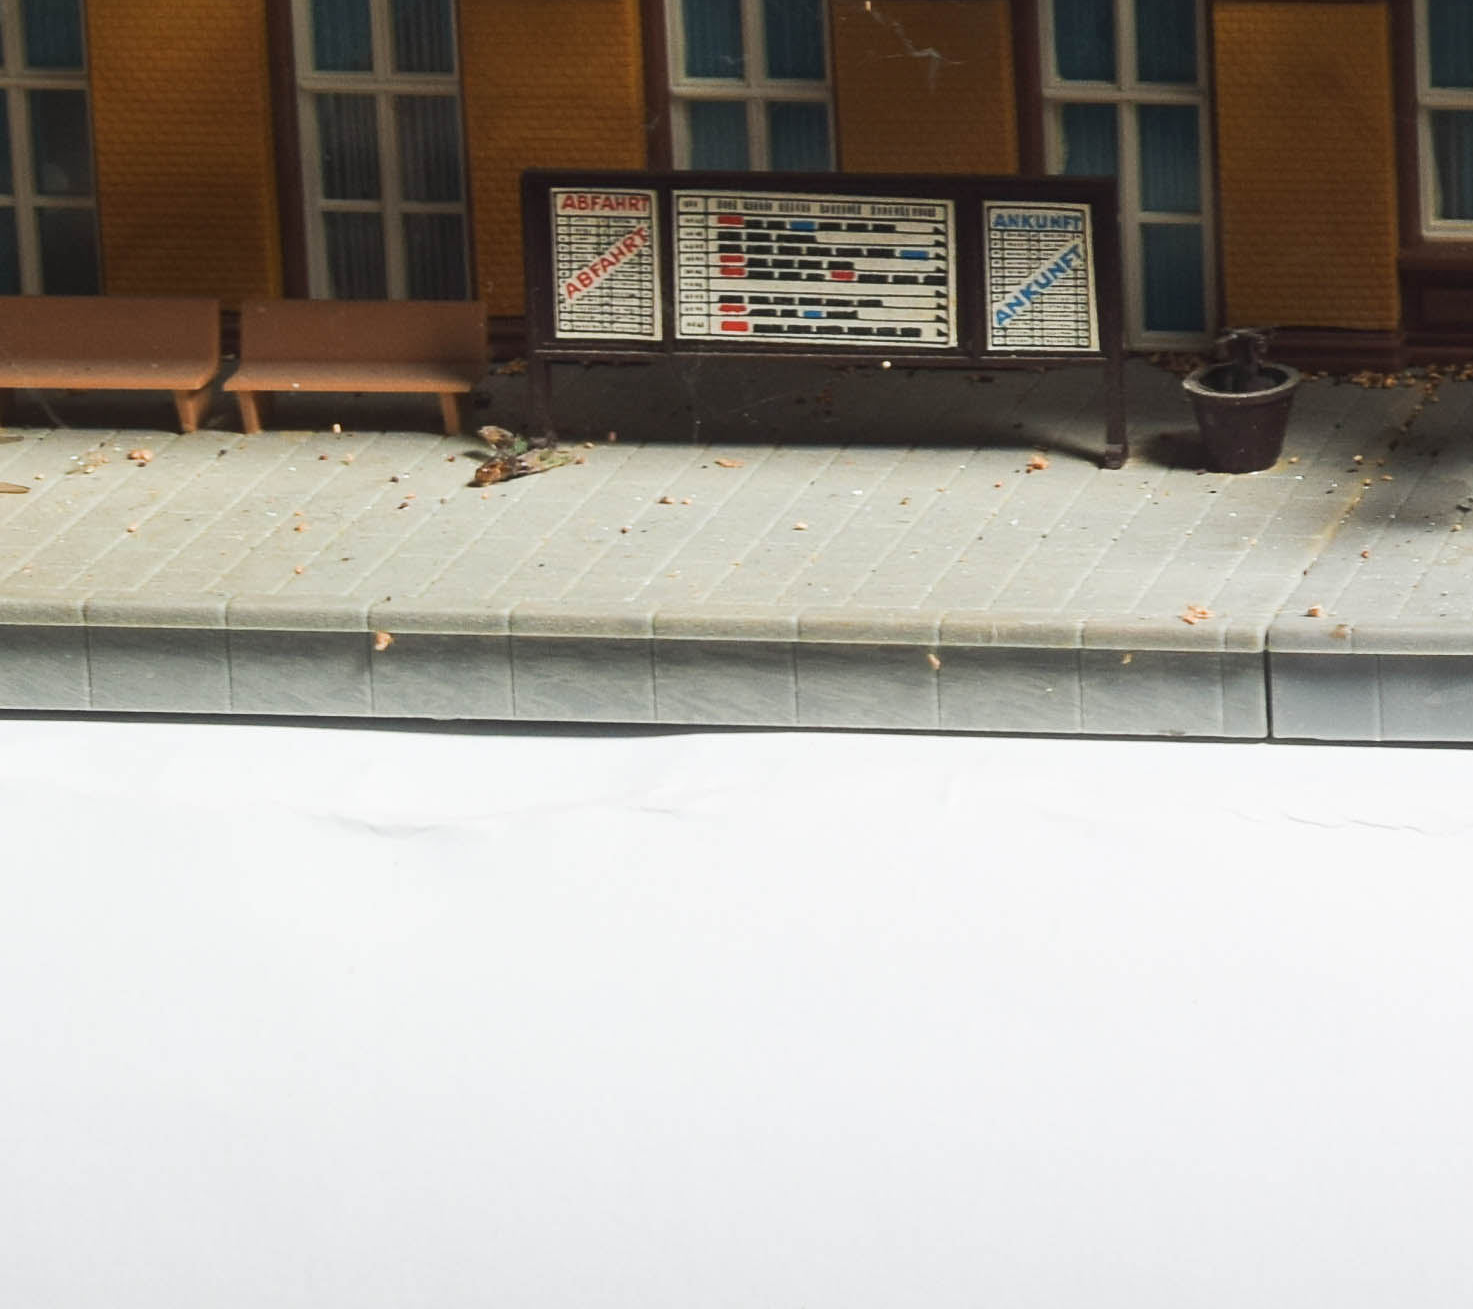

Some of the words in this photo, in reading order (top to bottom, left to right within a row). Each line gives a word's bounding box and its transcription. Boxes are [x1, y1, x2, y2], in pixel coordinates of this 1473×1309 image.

[561, 192, 651, 213] ABFAHRT
[993, 211, 1084, 232] ANKUNFT
[562, 225, 649, 301] ABFAHRT
[994, 243, 1084, 328] ANKUNFT
